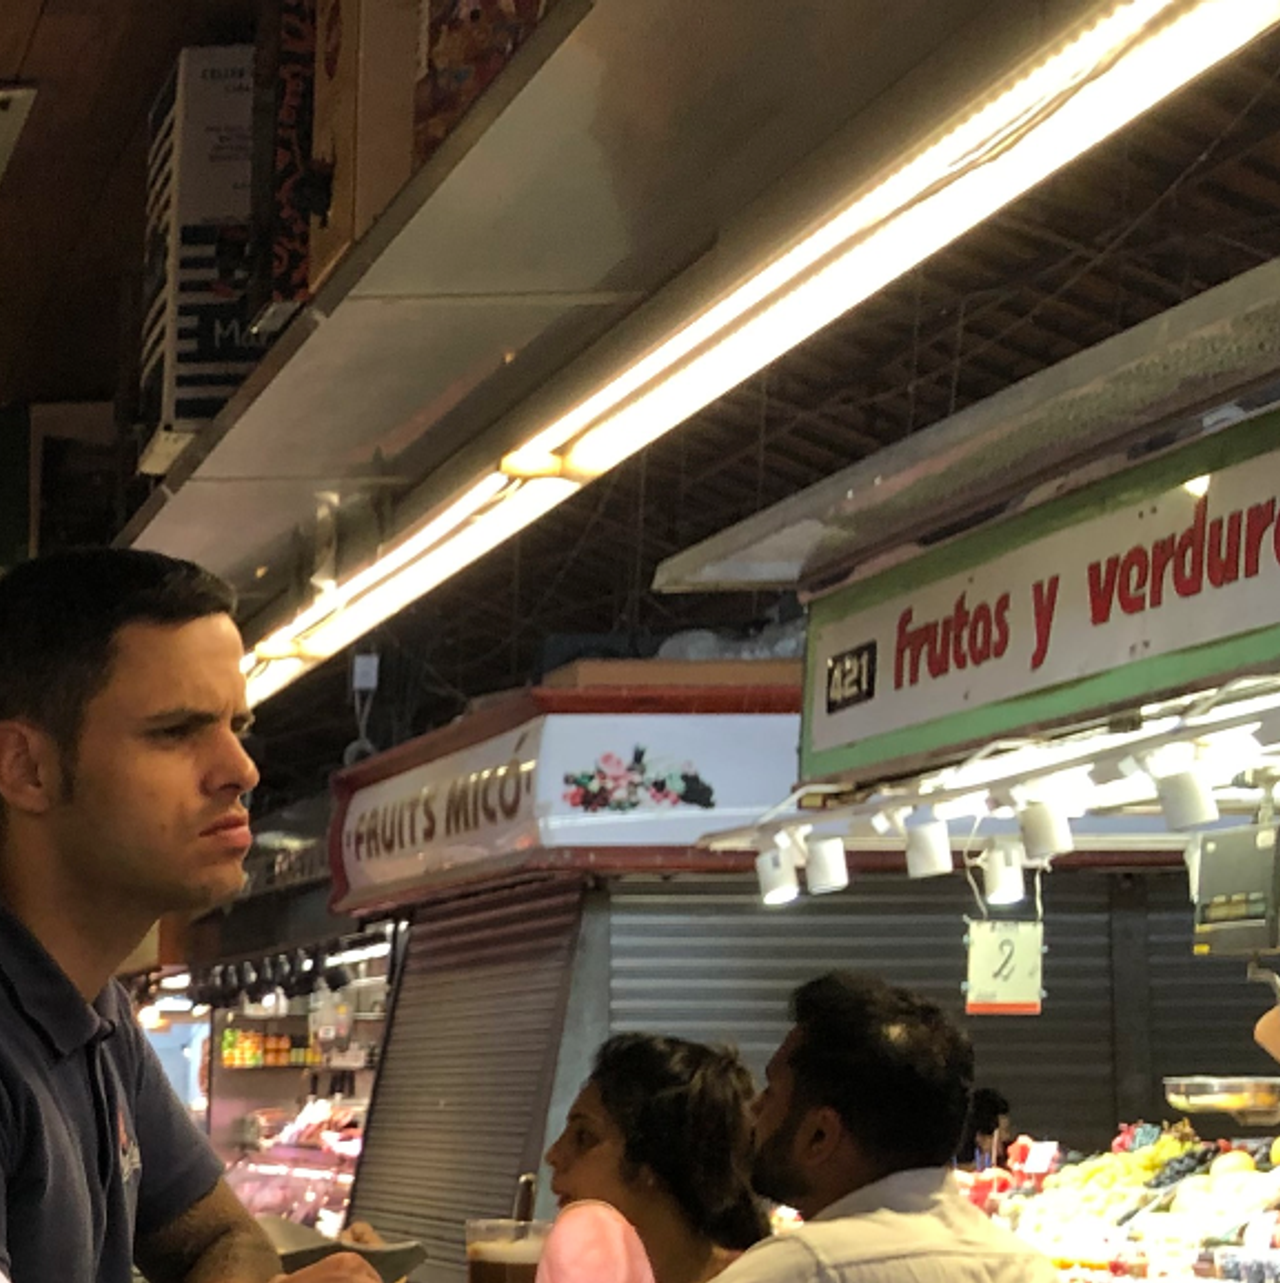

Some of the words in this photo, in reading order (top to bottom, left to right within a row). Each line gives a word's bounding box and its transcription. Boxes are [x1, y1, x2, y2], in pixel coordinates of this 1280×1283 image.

[893, 590, 1011, 692] frutas
[1030, 573, 1060, 672] y
[1087, 493, 1280, 627] verdur
